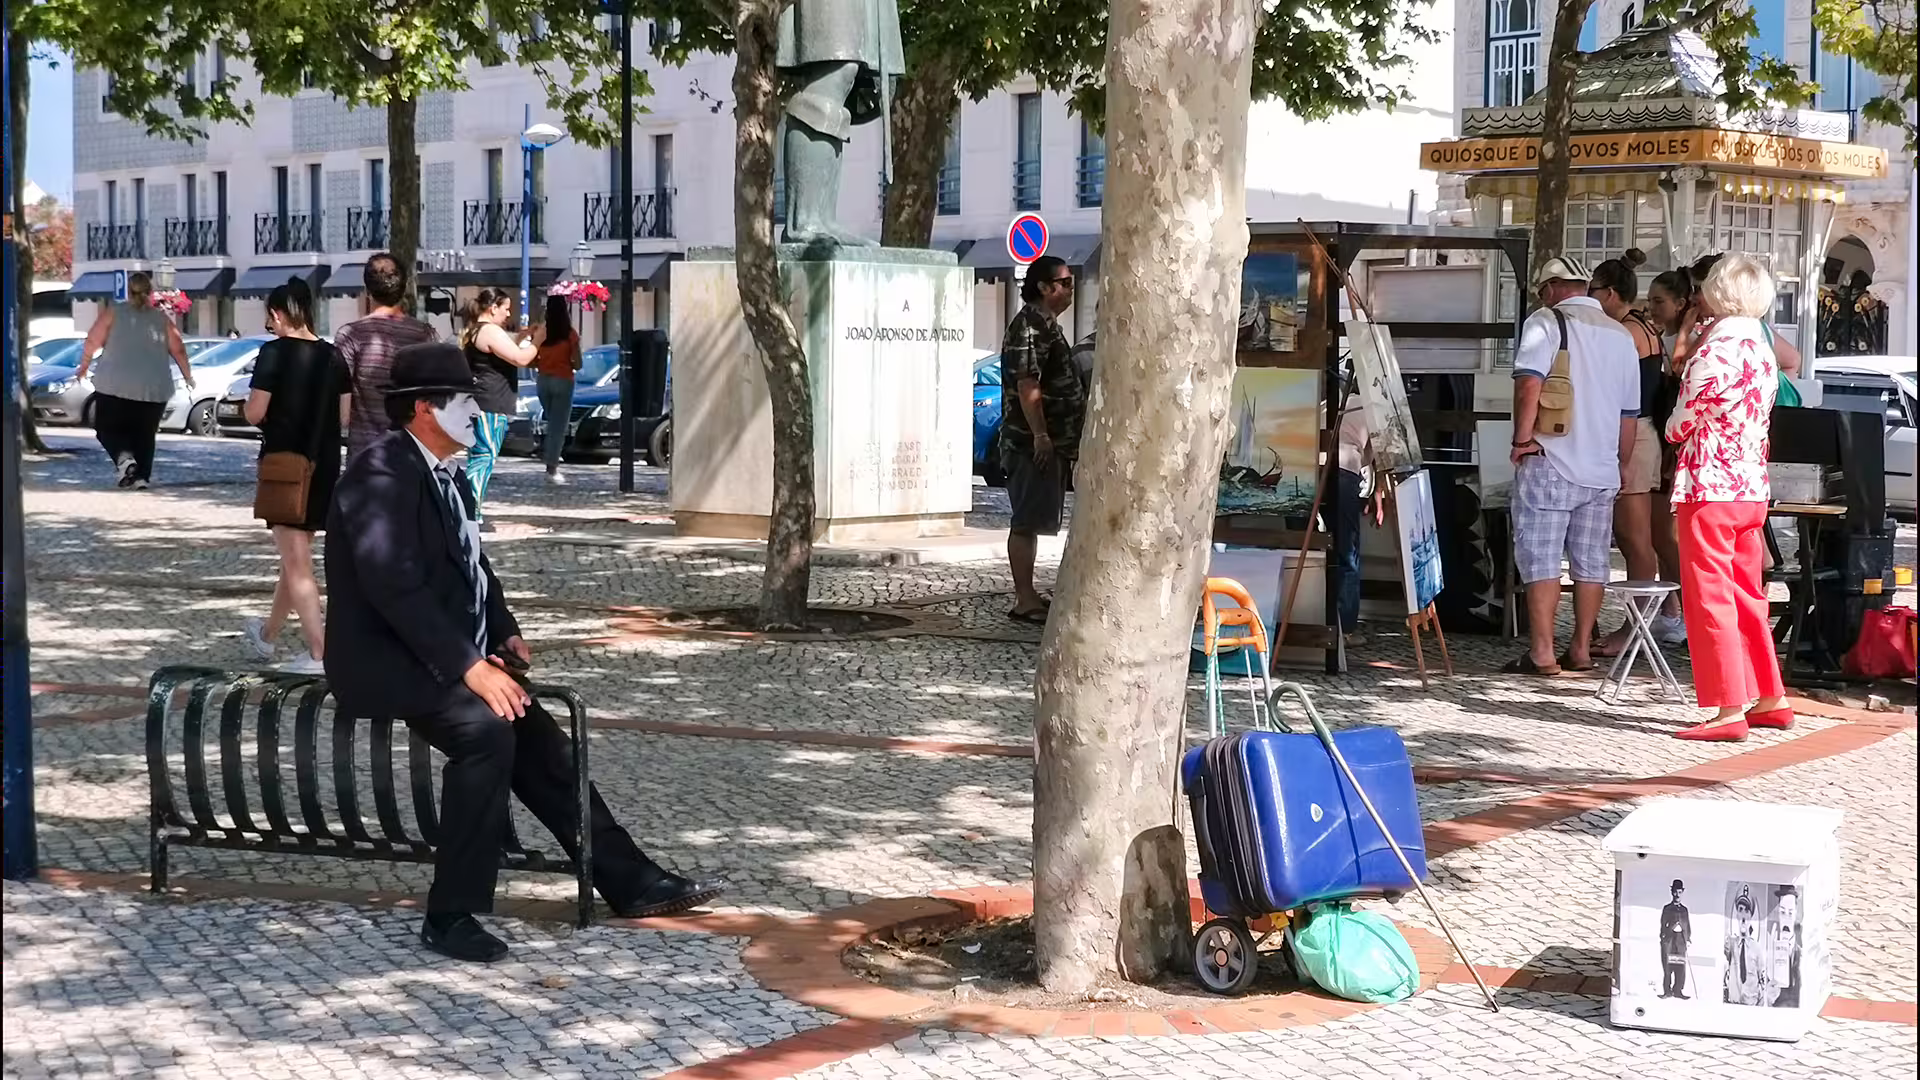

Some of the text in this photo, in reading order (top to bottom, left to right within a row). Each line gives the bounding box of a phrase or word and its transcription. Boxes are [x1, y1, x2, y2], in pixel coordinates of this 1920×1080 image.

[1430, 146, 1518, 163] QUIOSQUE
[1569, 142, 1619, 158] OVOS
[1627, 139, 1690, 156] MOLES
[1780, 146, 1803, 162] DOS
[1807, 149, 1839, 165] OVOS
[1843, 152, 1881, 170] MOLES
[115, 272, 124, 297] P
[902, 300, 910, 312] A
[873, 328, 914, 341] AFONSO
[916, 328, 928, 341] DE
[929, 328, 965, 342] AVEIRO
